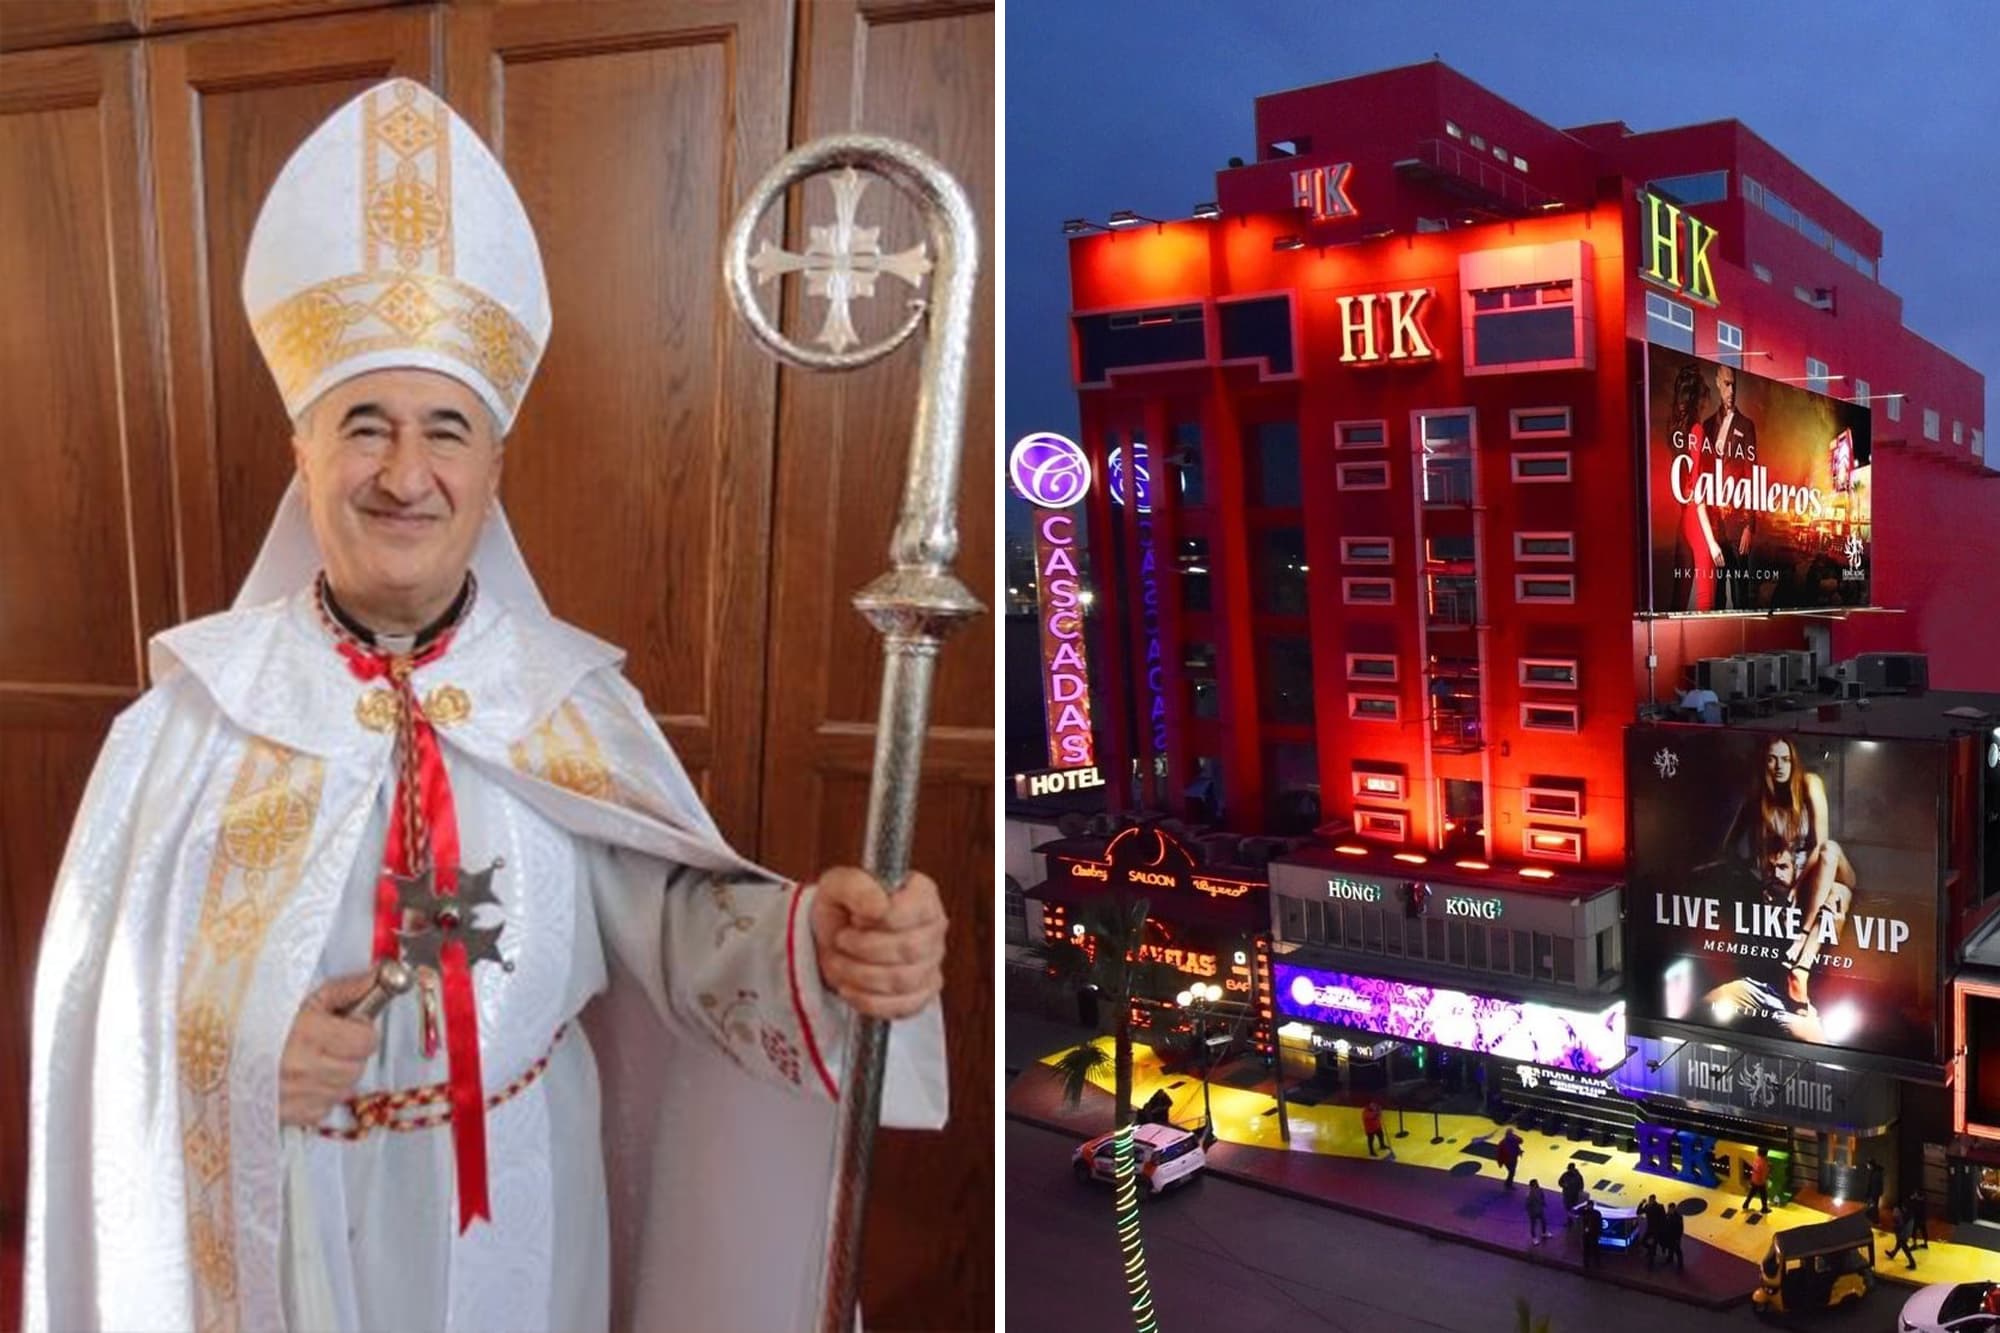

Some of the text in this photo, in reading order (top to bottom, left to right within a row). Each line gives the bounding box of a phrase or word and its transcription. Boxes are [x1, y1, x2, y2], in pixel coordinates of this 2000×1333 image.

[1289, 162, 1358, 220] HK
[1643, 192, 1720, 305] HK
[1336, 287, 1440, 364] HK
[1672, 431, 1756, 462] GRACIAS
[1670, 454, 1825, 517] Caballeros
[1673, 568, 1780, 580] HKTIJUANA.COM
[1042, 516, 1095, 764] CASCADAS
[1031, 767, 1105, 796] HOTEL
[1128, 870, 1176, 887] SALOON
[1328, 880, 1496, 919] HONG KONG
[1655, 893, 1910, 953] LIVE LIKE A VIP
[1703, 939, 1780, 960] MEMBERS
